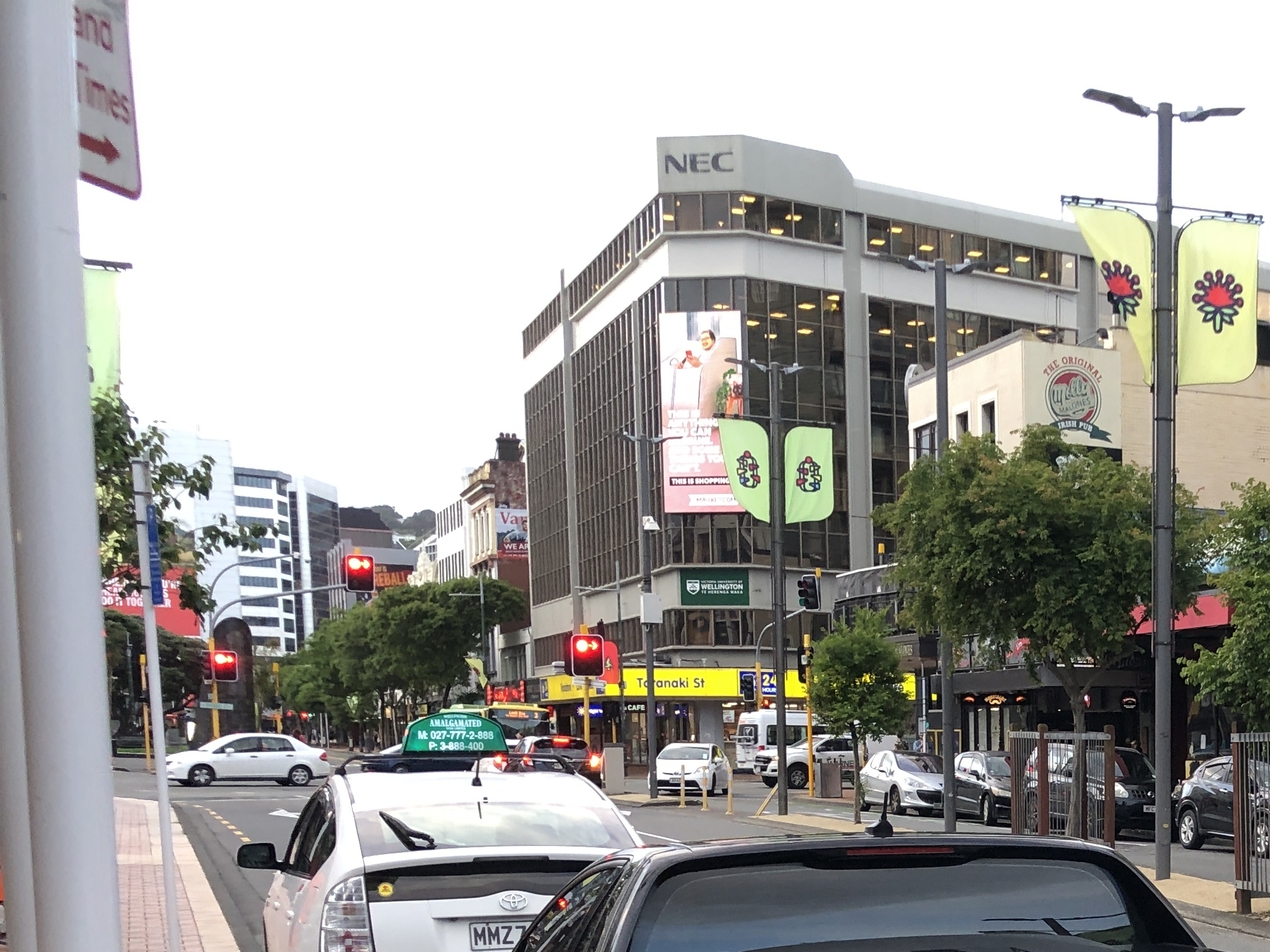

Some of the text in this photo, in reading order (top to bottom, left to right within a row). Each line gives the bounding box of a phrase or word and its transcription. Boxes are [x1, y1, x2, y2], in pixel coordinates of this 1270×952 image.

[664, 151, 734, 174] NEC
[1043, 356, 1103, 383] THE ORIGINAL
[1058, 420, 1093, 432] IRISH PUB
[690, 427, 712, 436] CAN
[694, 677, 705, 688] St
[430, 719, 481, 727] AMALGAMATED
[430, 731, 494, 740] 027-777-2-888
[429, 742, 484, 750] P: 3-888-400
